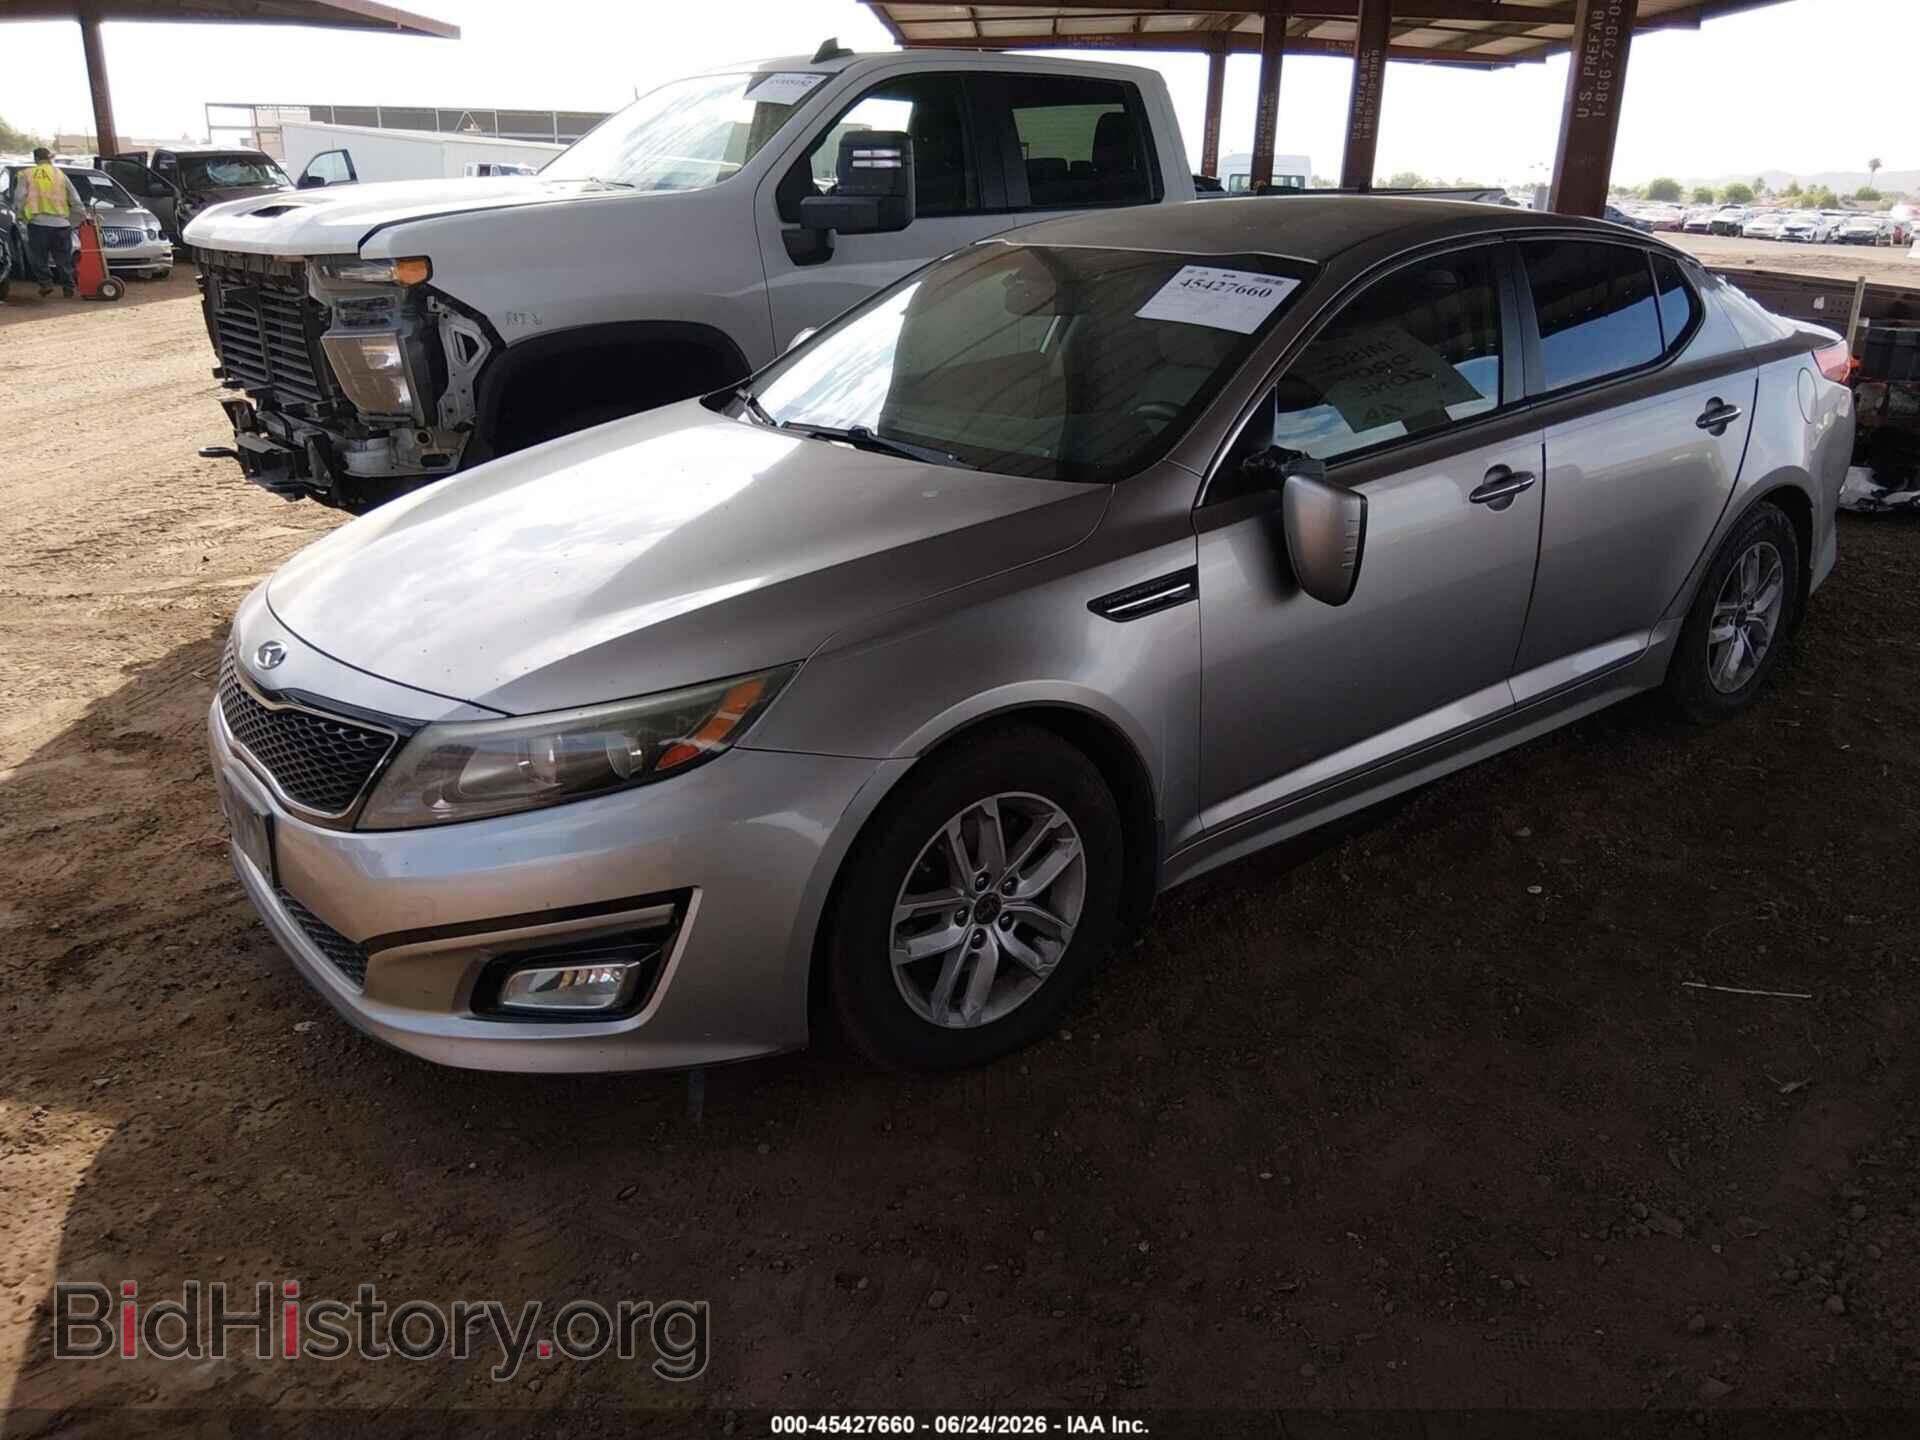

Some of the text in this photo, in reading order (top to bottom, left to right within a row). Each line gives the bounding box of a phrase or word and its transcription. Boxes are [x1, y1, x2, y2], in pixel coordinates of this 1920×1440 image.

[1576, 10, 1606, 119] U.S. PREFAB
[1179, 278, 1273, 298] 45427660
